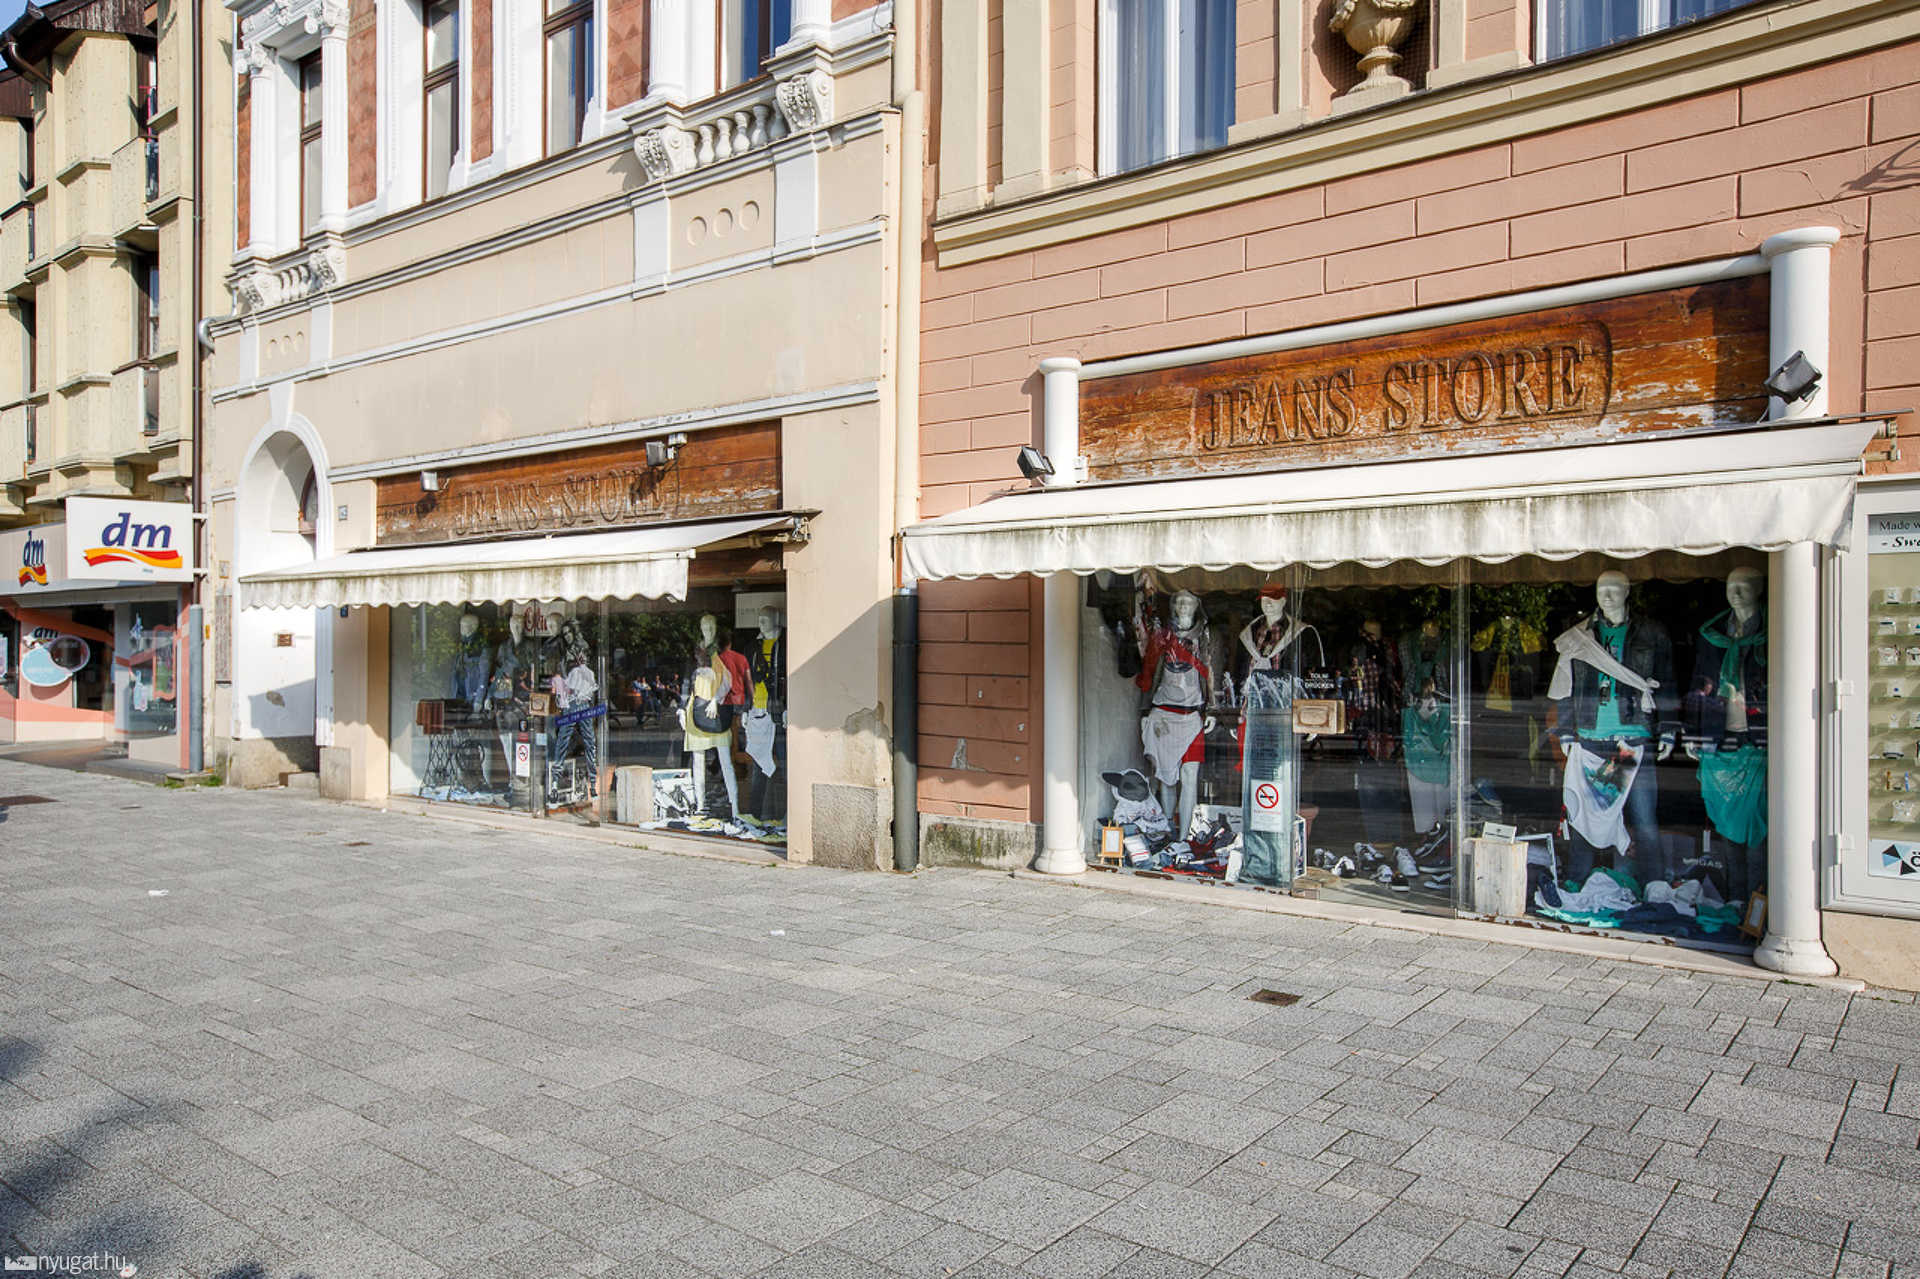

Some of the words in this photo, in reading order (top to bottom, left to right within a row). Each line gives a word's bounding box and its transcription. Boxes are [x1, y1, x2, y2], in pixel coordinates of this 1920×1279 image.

[1202, 367, 1357, 452] JEANS
[1384, 338, 1592, 433] STORE
[455, 480, 541, 535] JEANS
[1880, 520, 1911, 530] Made
[23, 530, 44, 567] dm
[102, 512, 172, 549] dm
